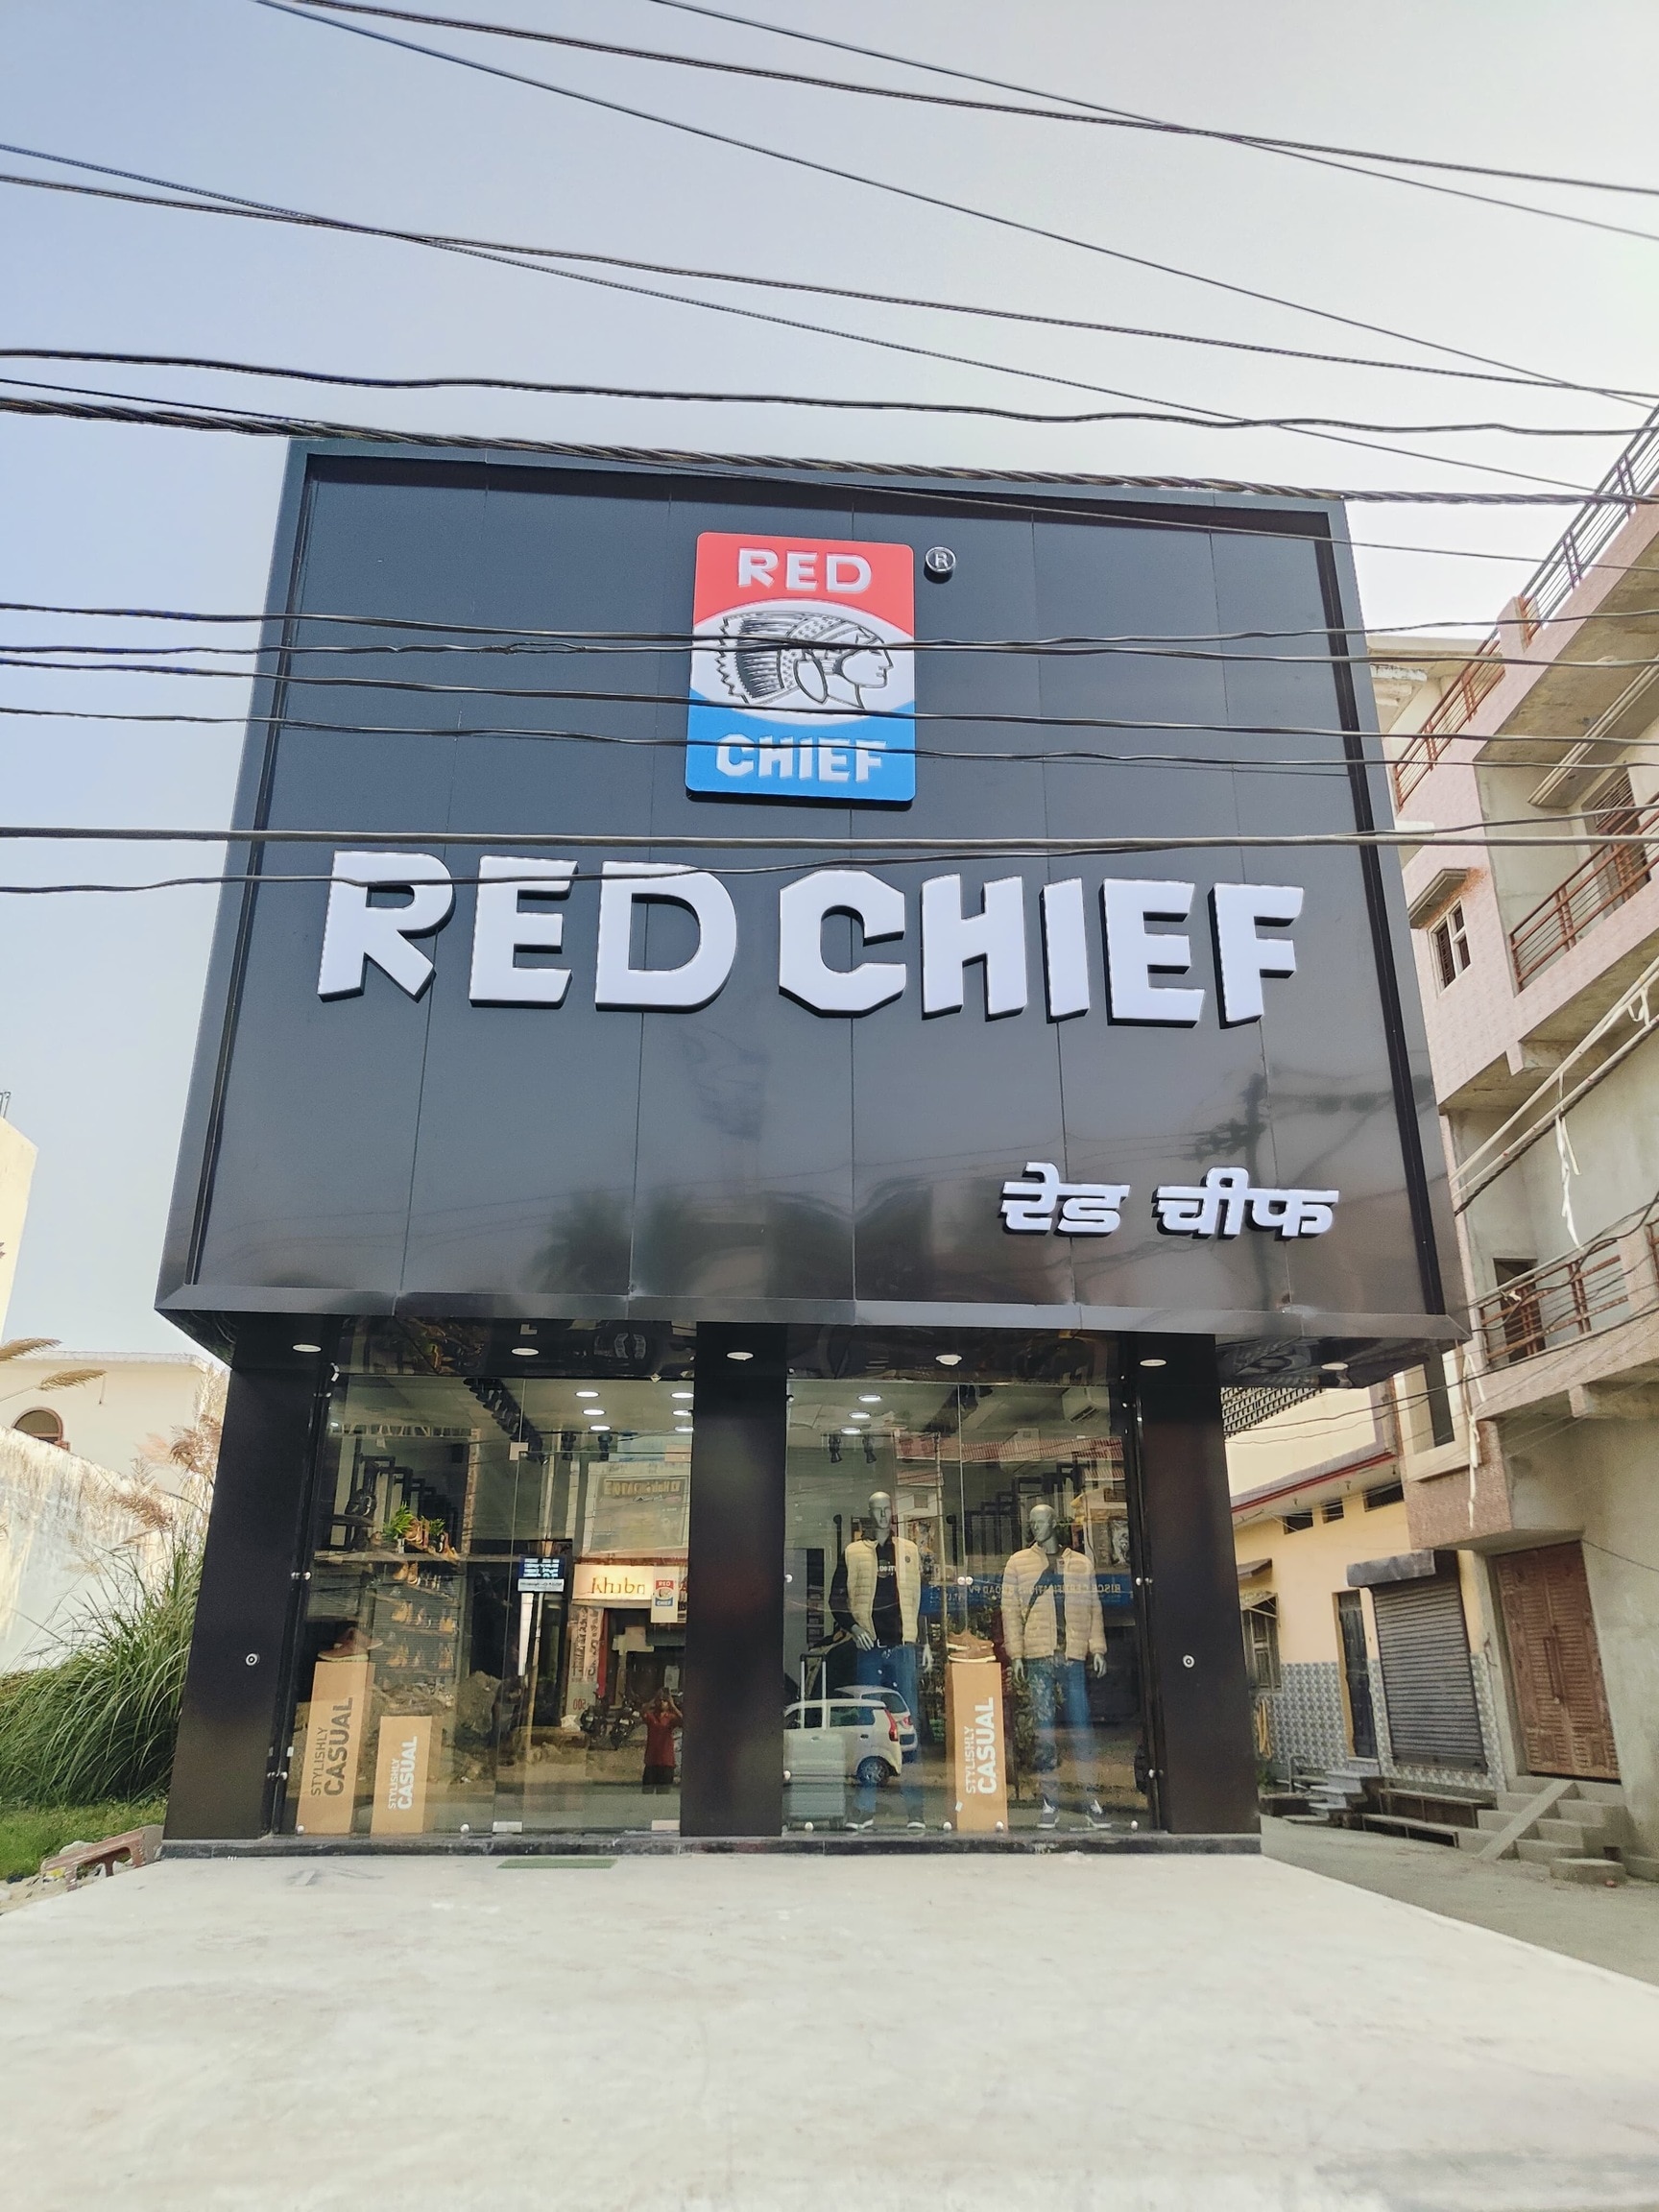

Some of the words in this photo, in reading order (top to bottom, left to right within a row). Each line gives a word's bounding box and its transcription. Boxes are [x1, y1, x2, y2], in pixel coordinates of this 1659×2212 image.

[737, 548, 872, 593] RED
[715, 733, 887, 782] CHIEF
[318, 850, 737, 1011] RED
[779, 868, 1304, 1027] CHIEF
[1001, 1162, 1130, 1236] रेड
[1154, 1166, 1339, 1238] चीफ
[311, 1727, 328, 1796] STYLISHLY
[324, 1697, 353, 1796] CASUAL
[397, 1736, 418, 1810] CASUAL
[964, 1725, 976, 1794] STYLISHLY
[974, 1697, 998, 1794] CASUAL
[388, 1758, 400, 1810] STYLISHLY
